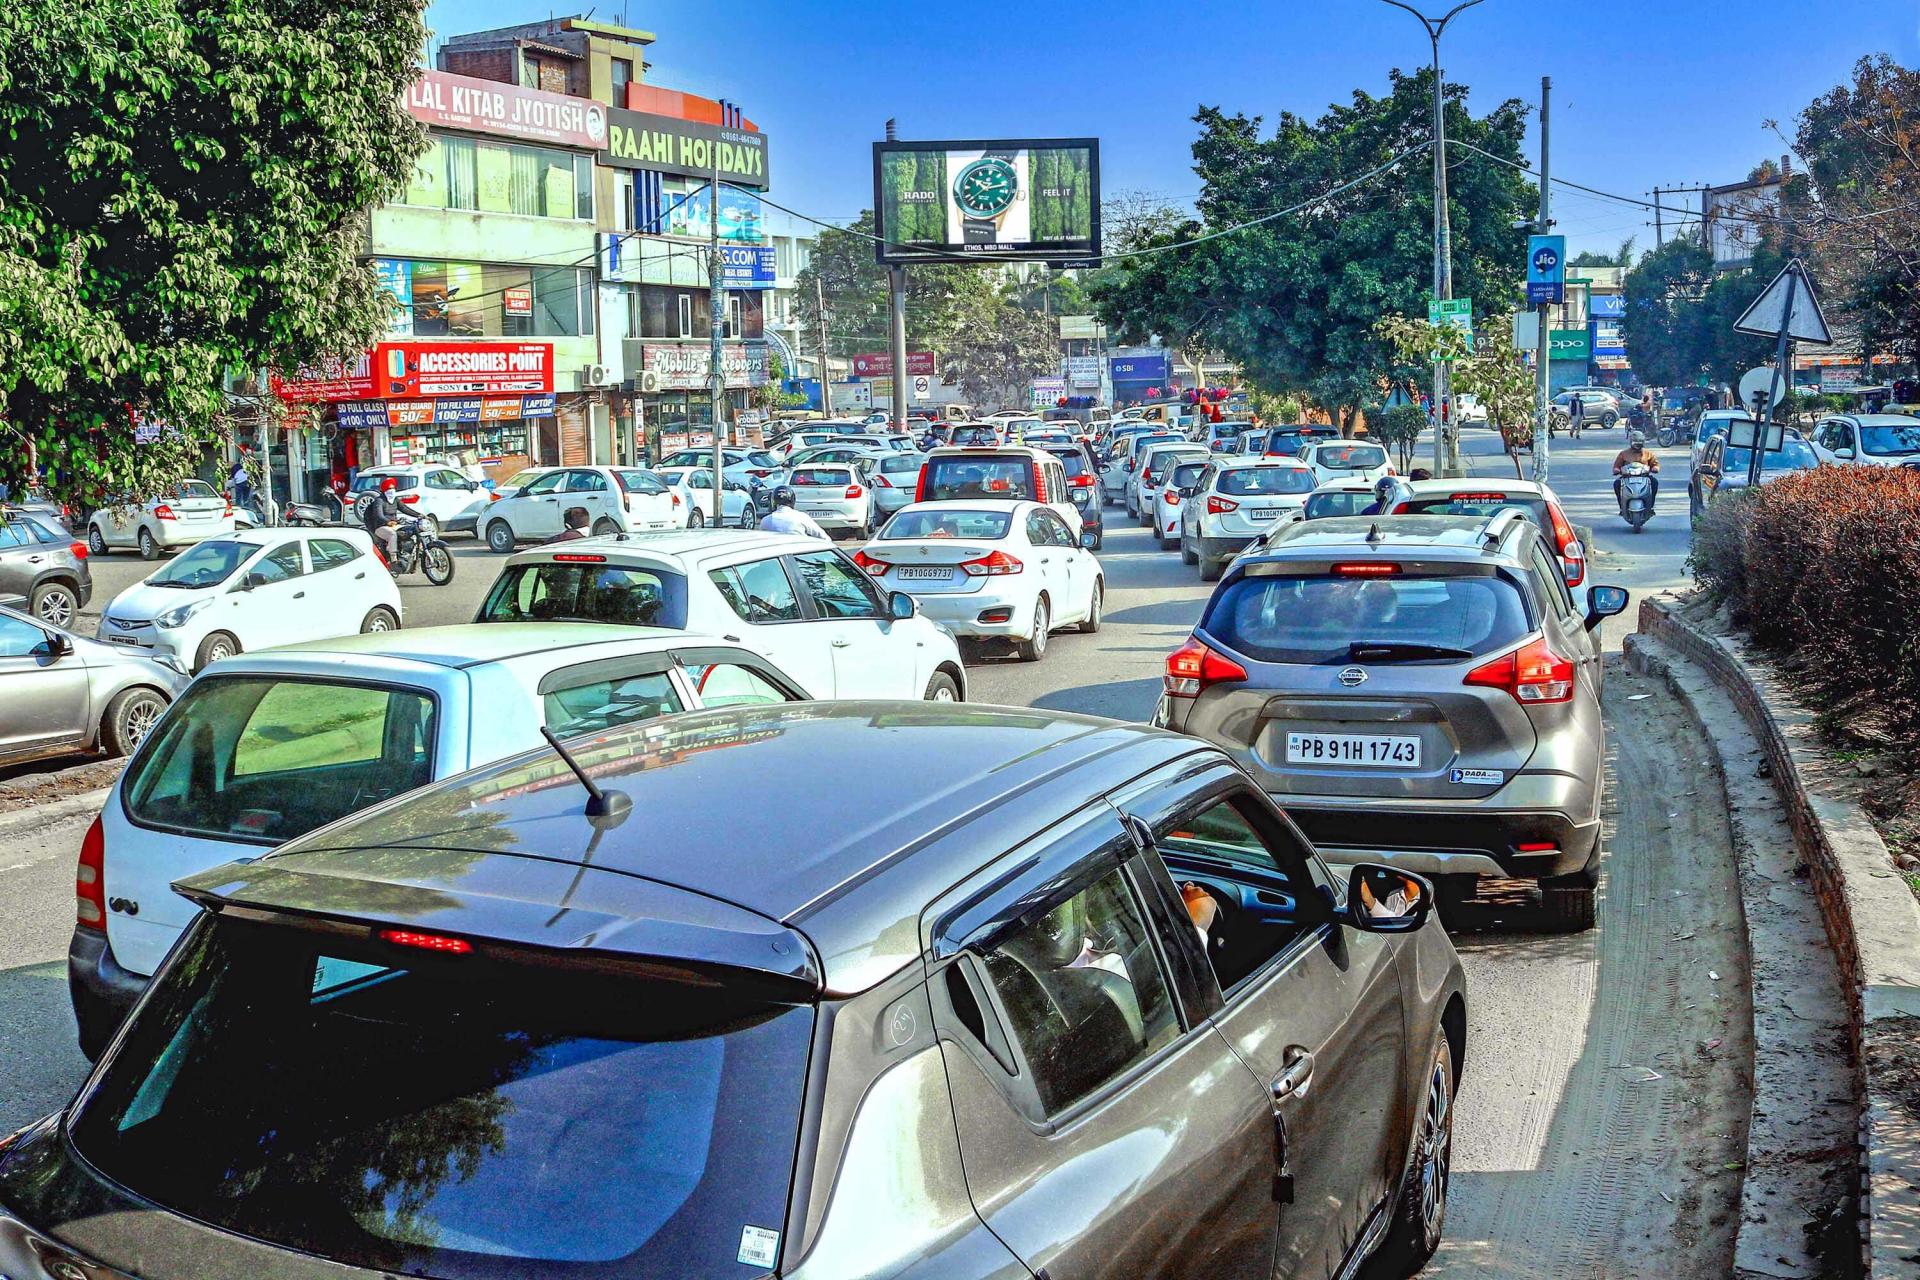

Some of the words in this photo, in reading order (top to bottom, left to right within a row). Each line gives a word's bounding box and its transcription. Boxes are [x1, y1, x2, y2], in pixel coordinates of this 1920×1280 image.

[411, 81, 447, 111] LAL
[452, 86, 506, 121] KITAB
[511, 97, 584, 133] JYOTISH
[609, 125, 674, 165] RAAHI
[904, 191, 935, 200] RADO
[1042, 189, 1062, 197] FEEL
[1063, 188, 1071, 197] IT
[1535, 252, 1556, 266] Jio
[1606, 298, 1628, 310] viv
[1550, 339, 1584, 349] ppo
[420, 352, 507, 373] ACCESSORIES
[508, 351, 545, 372] POINT
[655, 350, 697, 374] Mobile
[437, 384, 461, 392] SONY
[348, 403, 362, 413] FULL
[363, 402, 385, 412] GLASS
[388, 403, 409, 411] GLASS
[410, 402, 433, 410] GUARD
[463, 400, 481, 409] GLASS
[525, 398, 553, 408] LAPTOP
[366, 414, 387, 425] ONLY
[904, 568, 952, 577] PB10GG9737
[1302, 739, 1324, 758] PB
[1329, 740, 1363, 760] 91H
[1370, 742, 1415, 761] 1743
